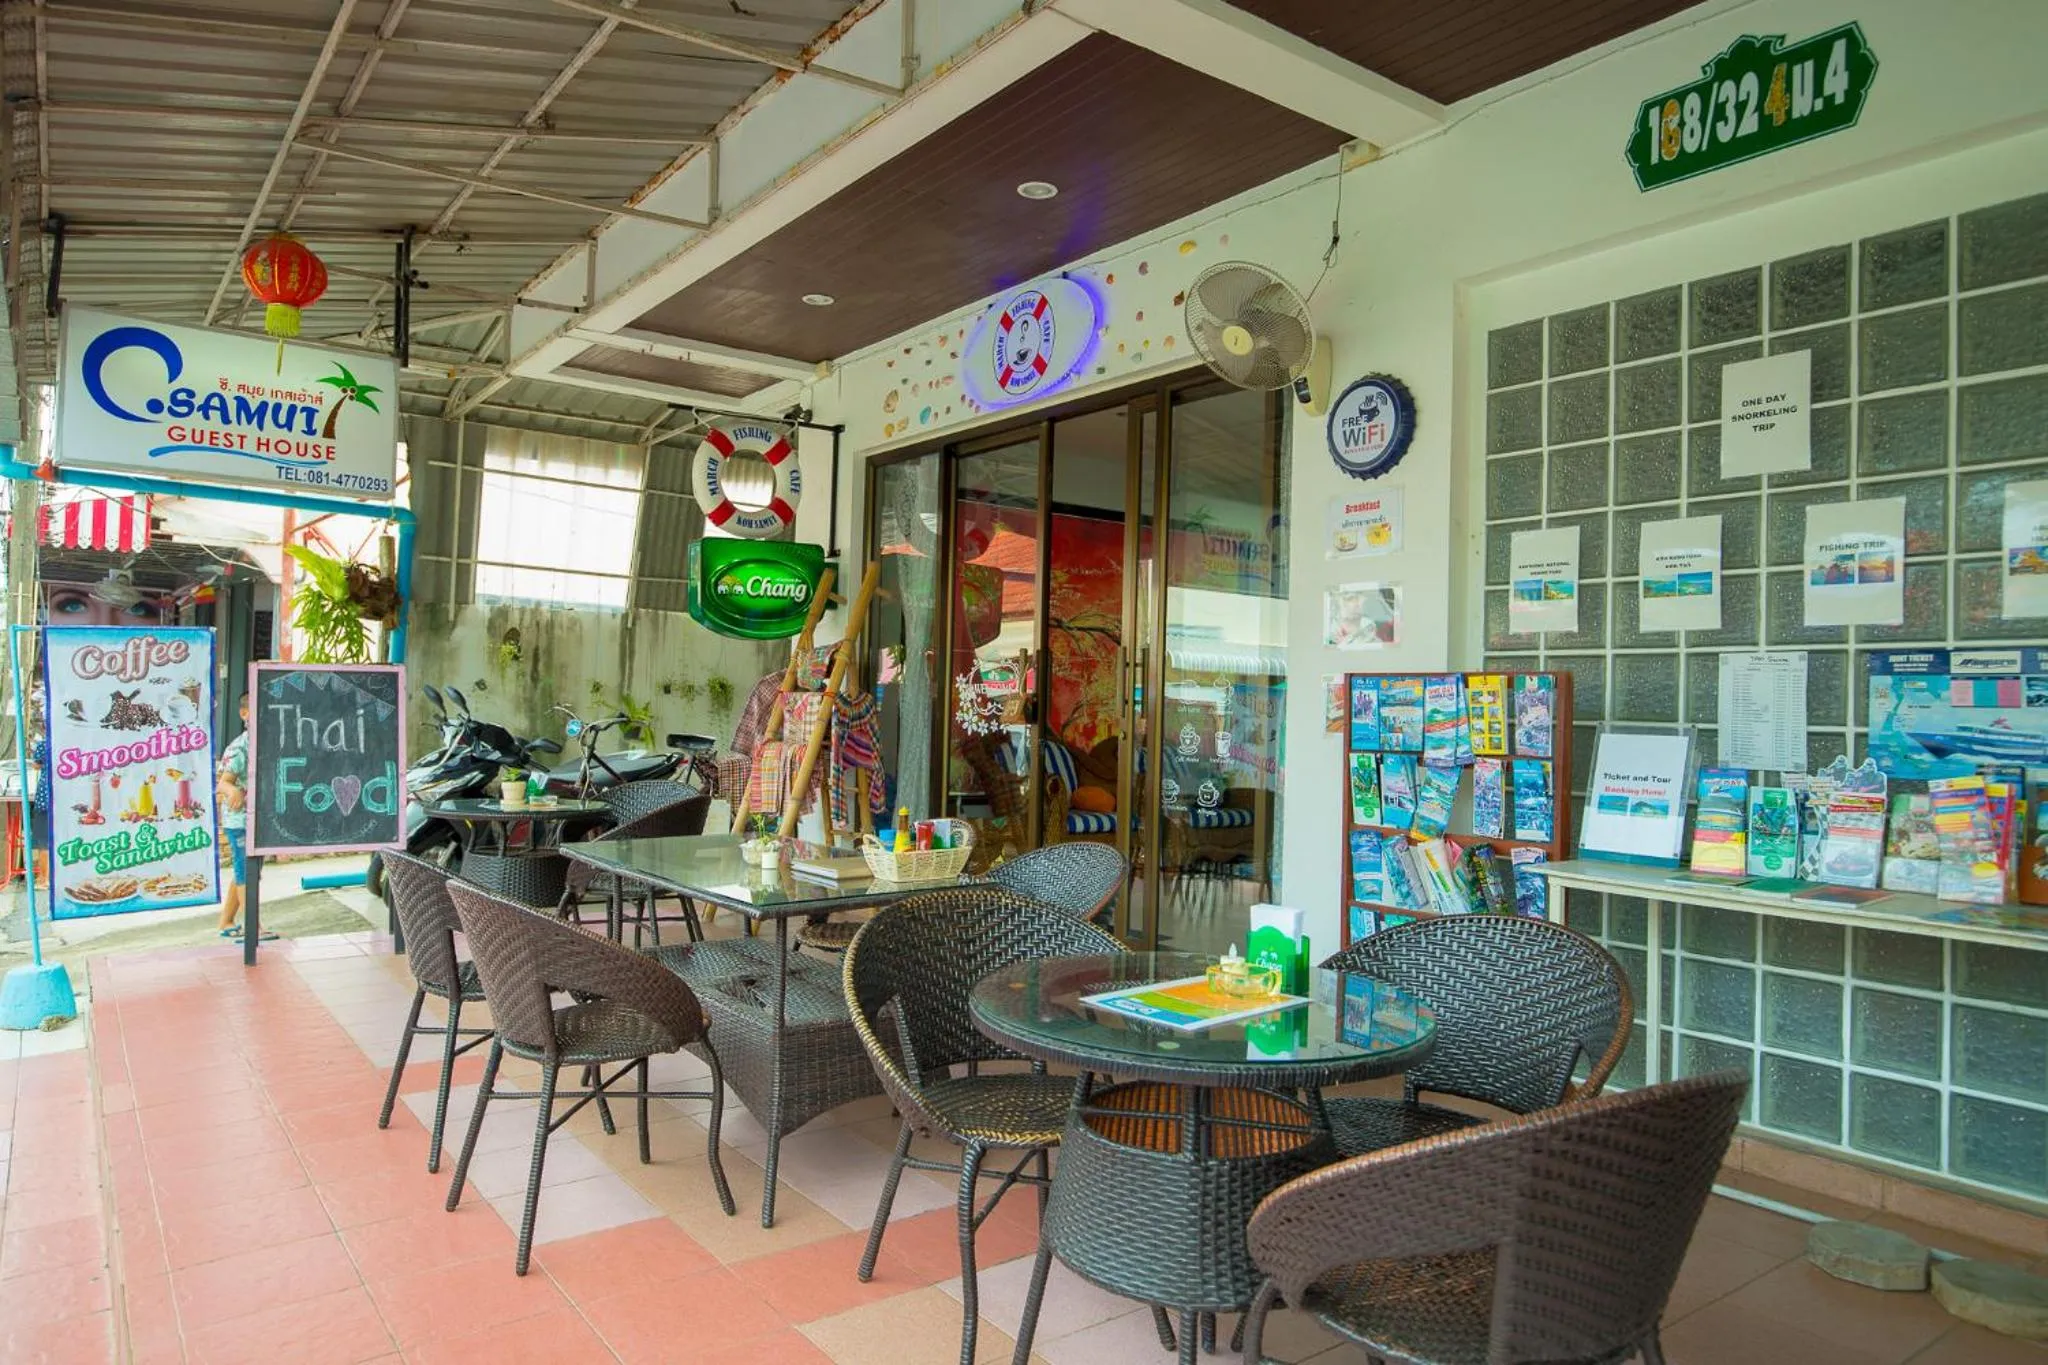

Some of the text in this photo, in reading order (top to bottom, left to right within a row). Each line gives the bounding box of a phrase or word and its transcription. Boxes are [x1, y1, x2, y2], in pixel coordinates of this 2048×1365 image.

[1731, 405, 1798, 422] SNORKELING
[1741, 394, 1787, 408] ONE DAY
[733, 426, 772, 442] FISHING
[1752, 422, 1776, 433] TRIP
[167, 425, 336, 460] GUEST HOUSE
[706, 456, 719, 496] MARCH
[780, 469, 801, 493] CAFE
[1819, 541, 1887, 552] FISHING TRIP
[747, 575, 807, 603] Chang
[72, 634, 190, 682] Coffee
[268, 703, 365, 754] Thai
[57, 724, 208, 780] Smoothie
[1604, 772, 1630, 781] Ticket
[1652, 775, 1672, 784] Tour
[58, 823, 158, 866] Toast &
[95, 826, 212, 874] Sandwich
